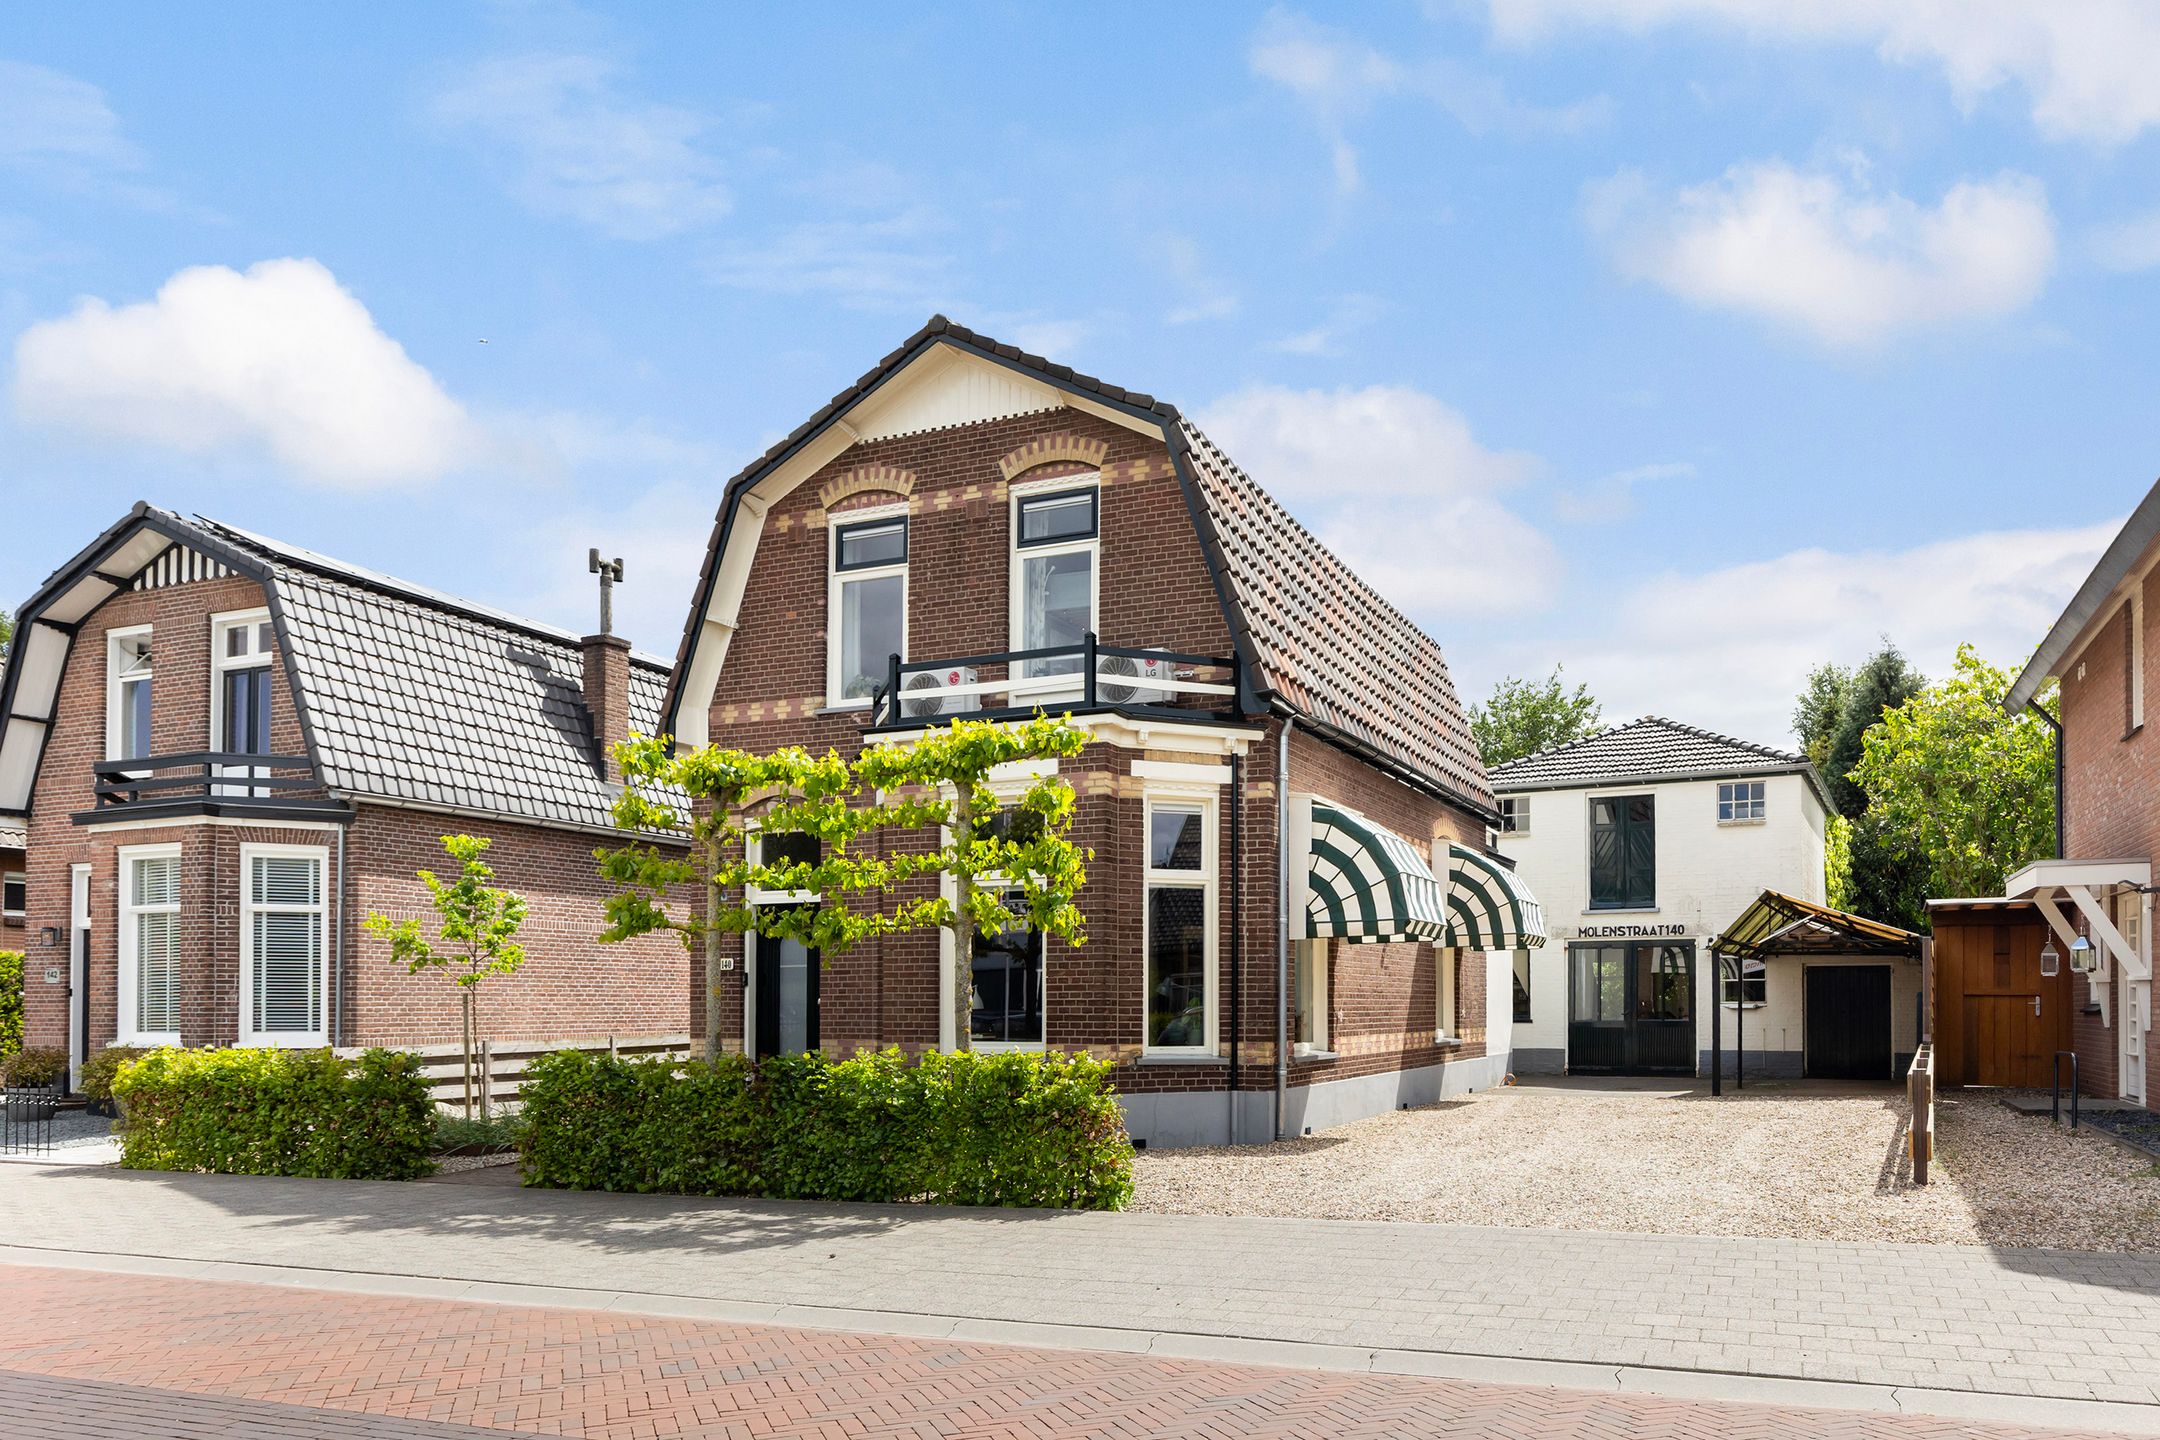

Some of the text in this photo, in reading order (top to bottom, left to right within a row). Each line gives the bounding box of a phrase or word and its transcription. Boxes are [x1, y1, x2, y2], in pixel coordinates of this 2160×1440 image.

[1145, 668, 1157, 677] LG
[721, 960, 732, 969] 140
[46, 970, 58, 979] 142
